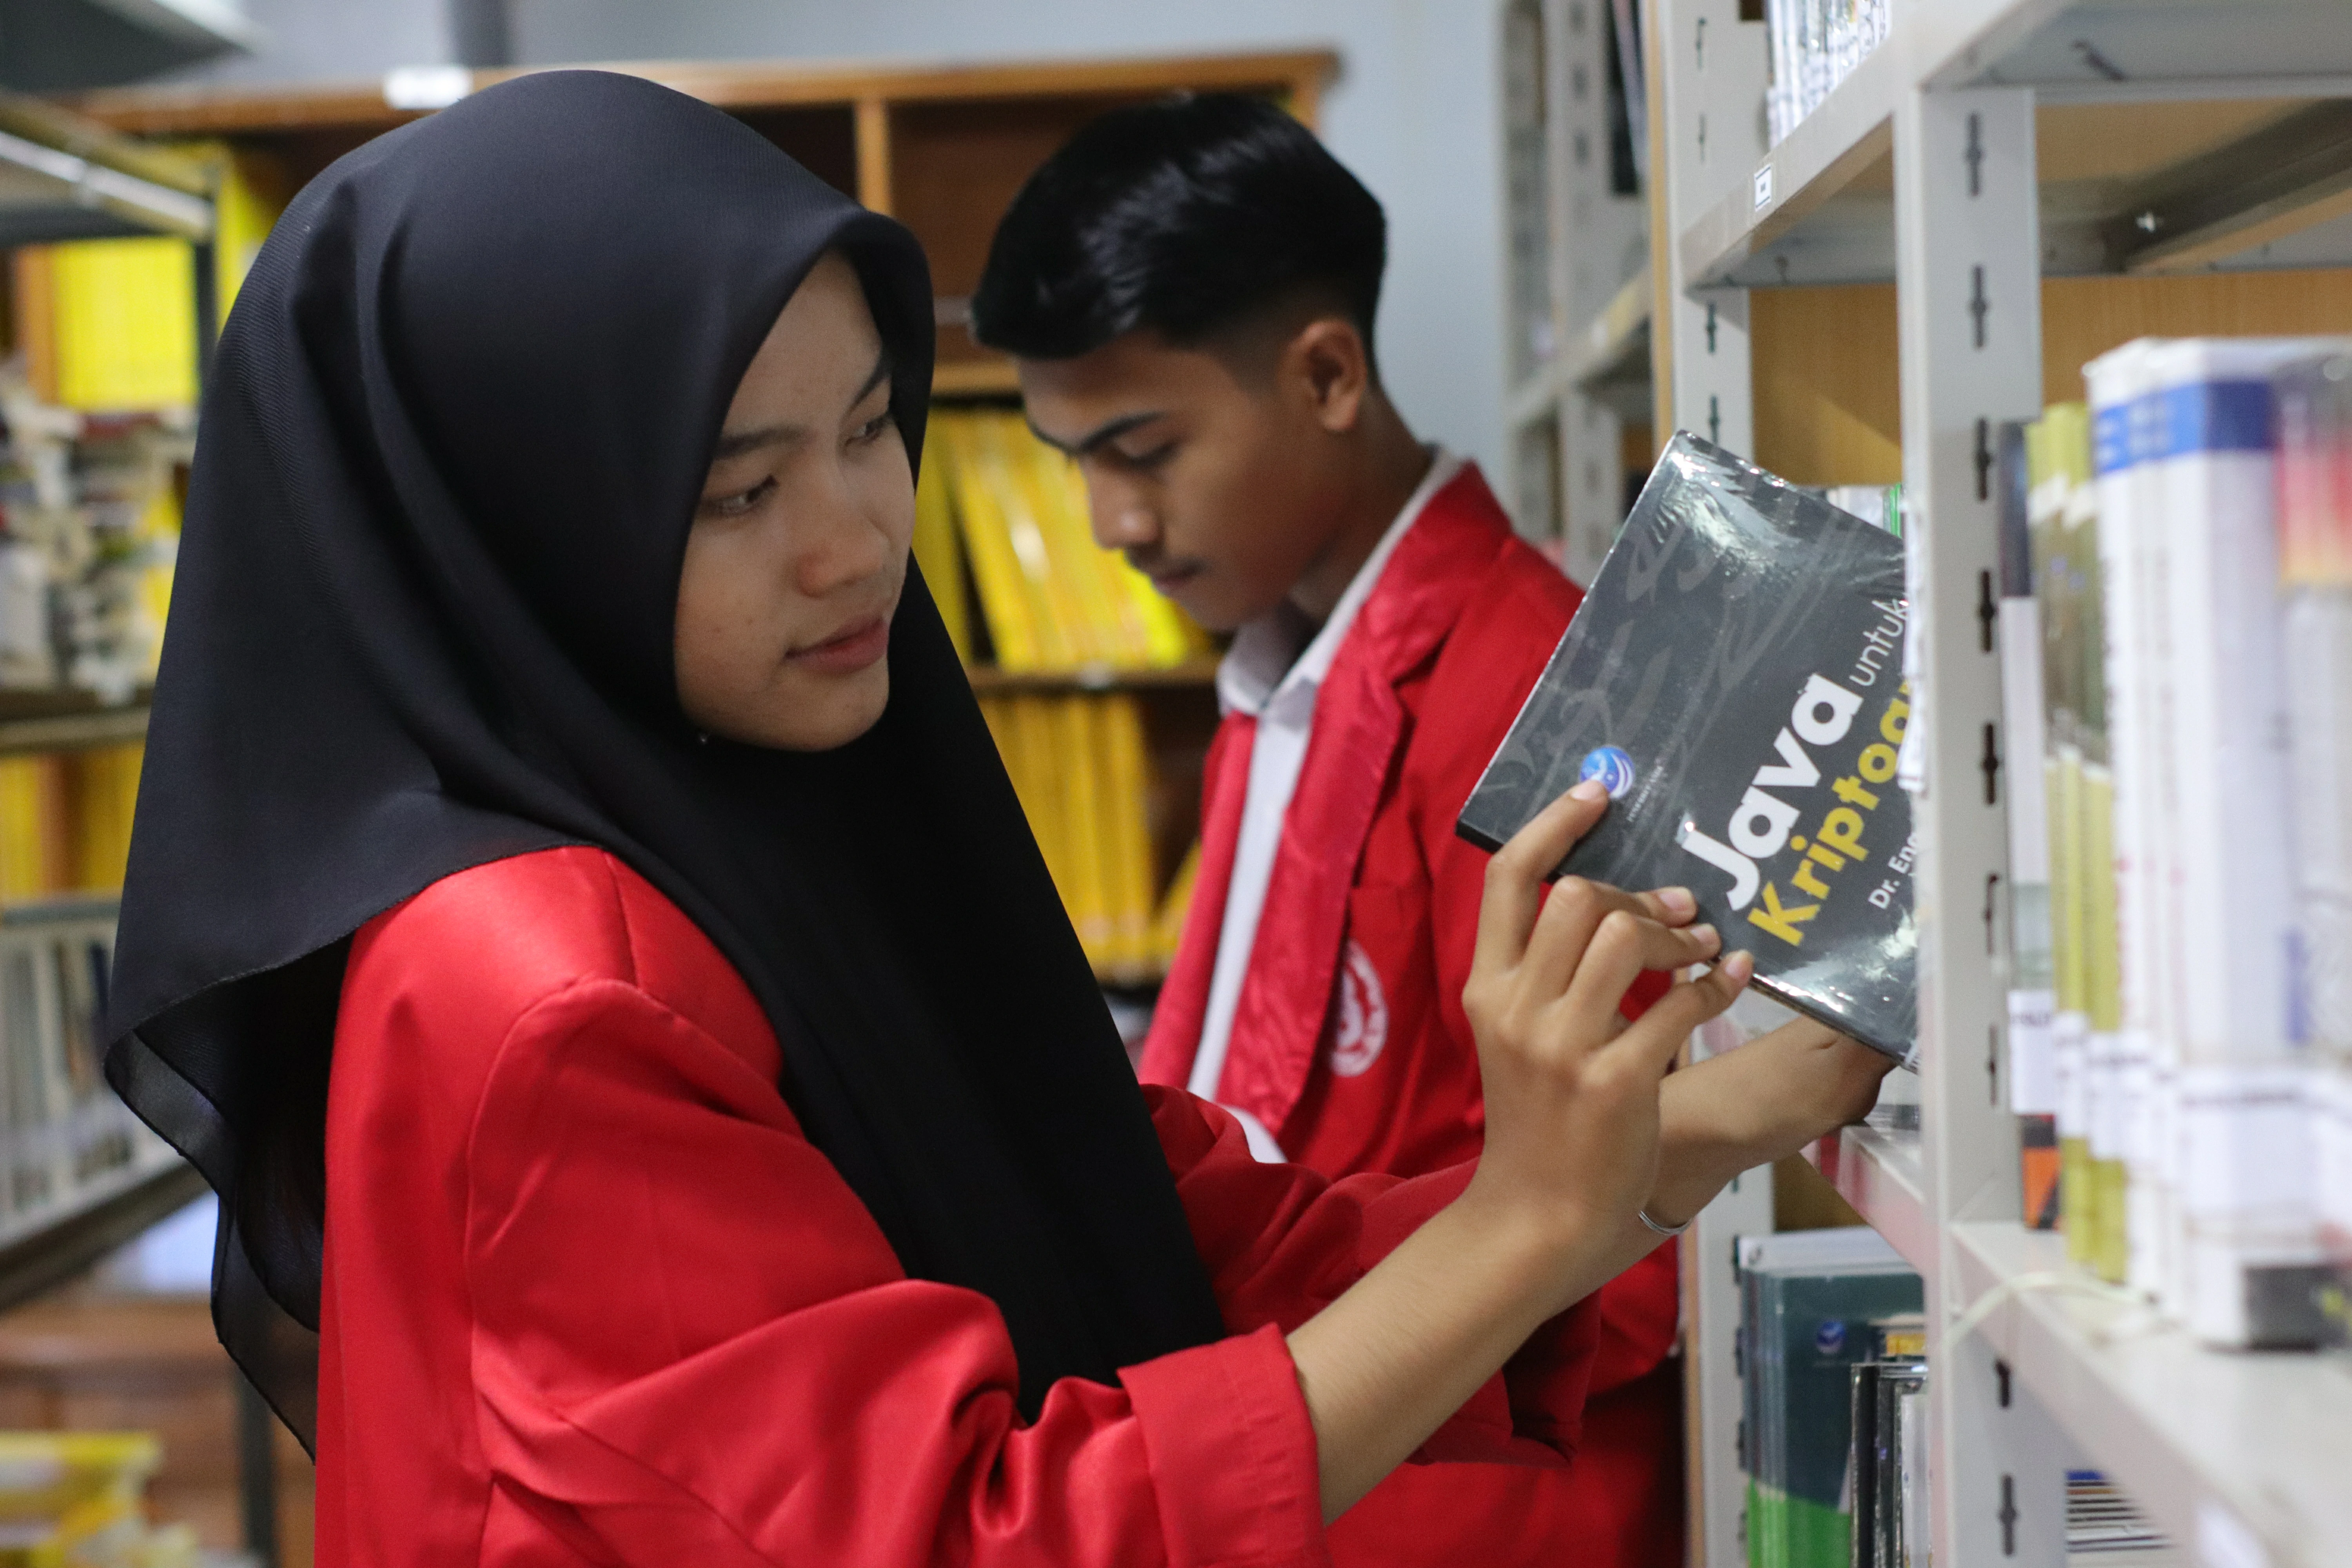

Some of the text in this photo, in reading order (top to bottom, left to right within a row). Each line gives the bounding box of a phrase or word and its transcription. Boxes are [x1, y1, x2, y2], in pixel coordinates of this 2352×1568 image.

[1676, 599, 1909, 911] Java untuk
[1868, 879, 1900, 909] Dr.
